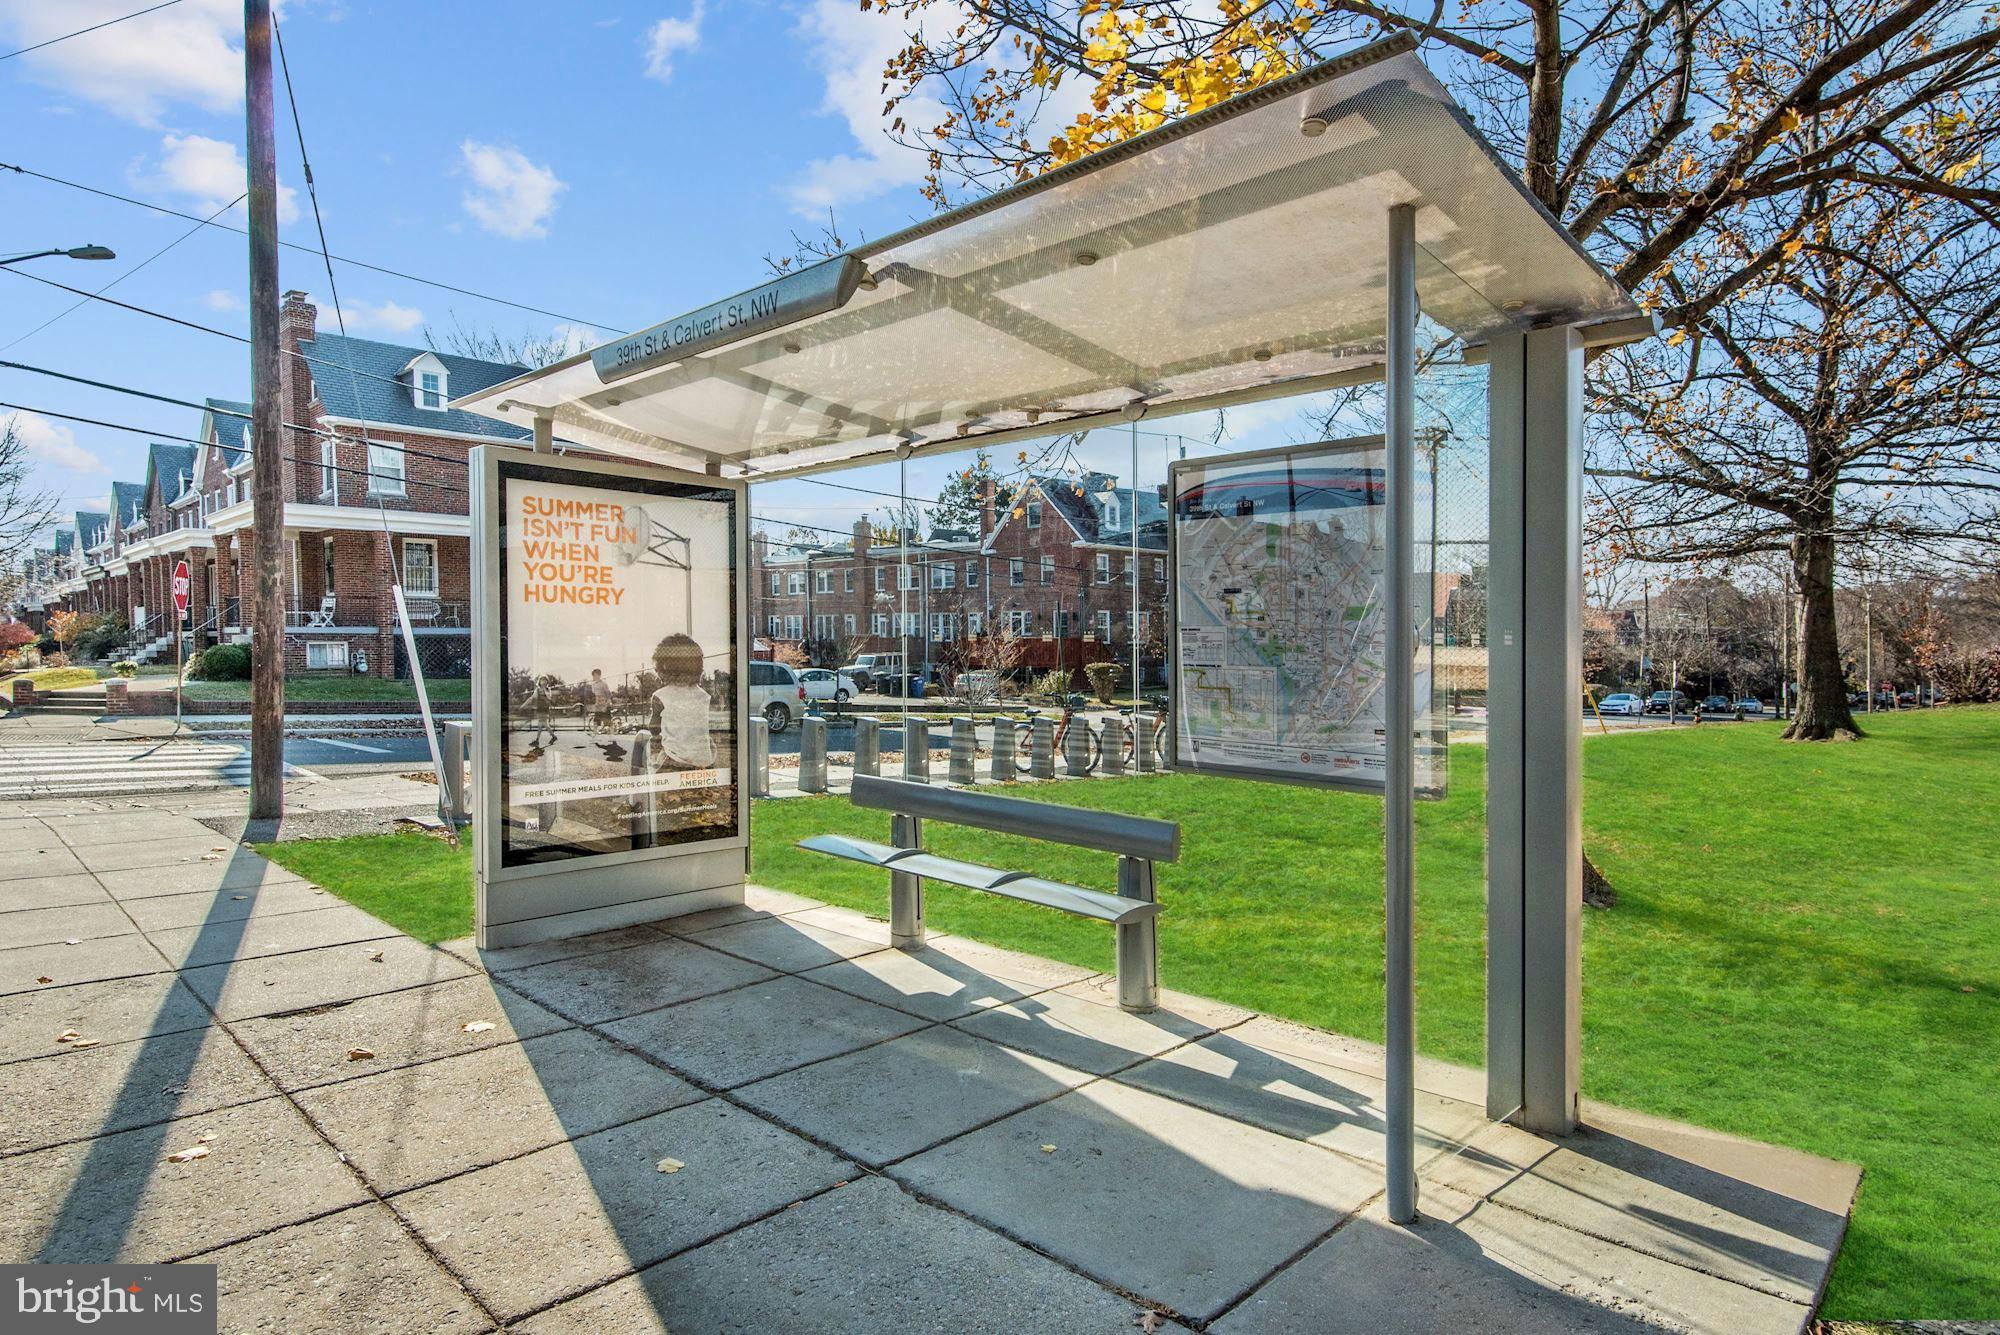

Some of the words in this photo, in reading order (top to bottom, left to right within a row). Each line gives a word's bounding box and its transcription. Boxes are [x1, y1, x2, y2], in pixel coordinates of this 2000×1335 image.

[616, 343, 642, 367] 39th
[645, 335, 658, 356] St
[662, 331, 672, 351] &
[674, 314, 723, 346] Calvert
[727, 304, 748, 327] St,
[751, 289, 779, 320] NW
[522, 495, 625, 523] SUMMER
[523, 518, 584, 539] ISN'T
[591, 524, 637, 545] FUN
[523, 540, 600, 562] WHEN
[523, 561, 613, 585] YOU'RE
[175, 576, 189, 595] STOP
[523, 583, 625, 605] HUNGRY
[680, 770, 717, 780] FEEDING
[680, 778, 718, 788] AMERICA
[525, 790, 544, 798] FREE
[546, 787, 576, 796] SUMMER
[578, 785, 602, 793] MEALS
